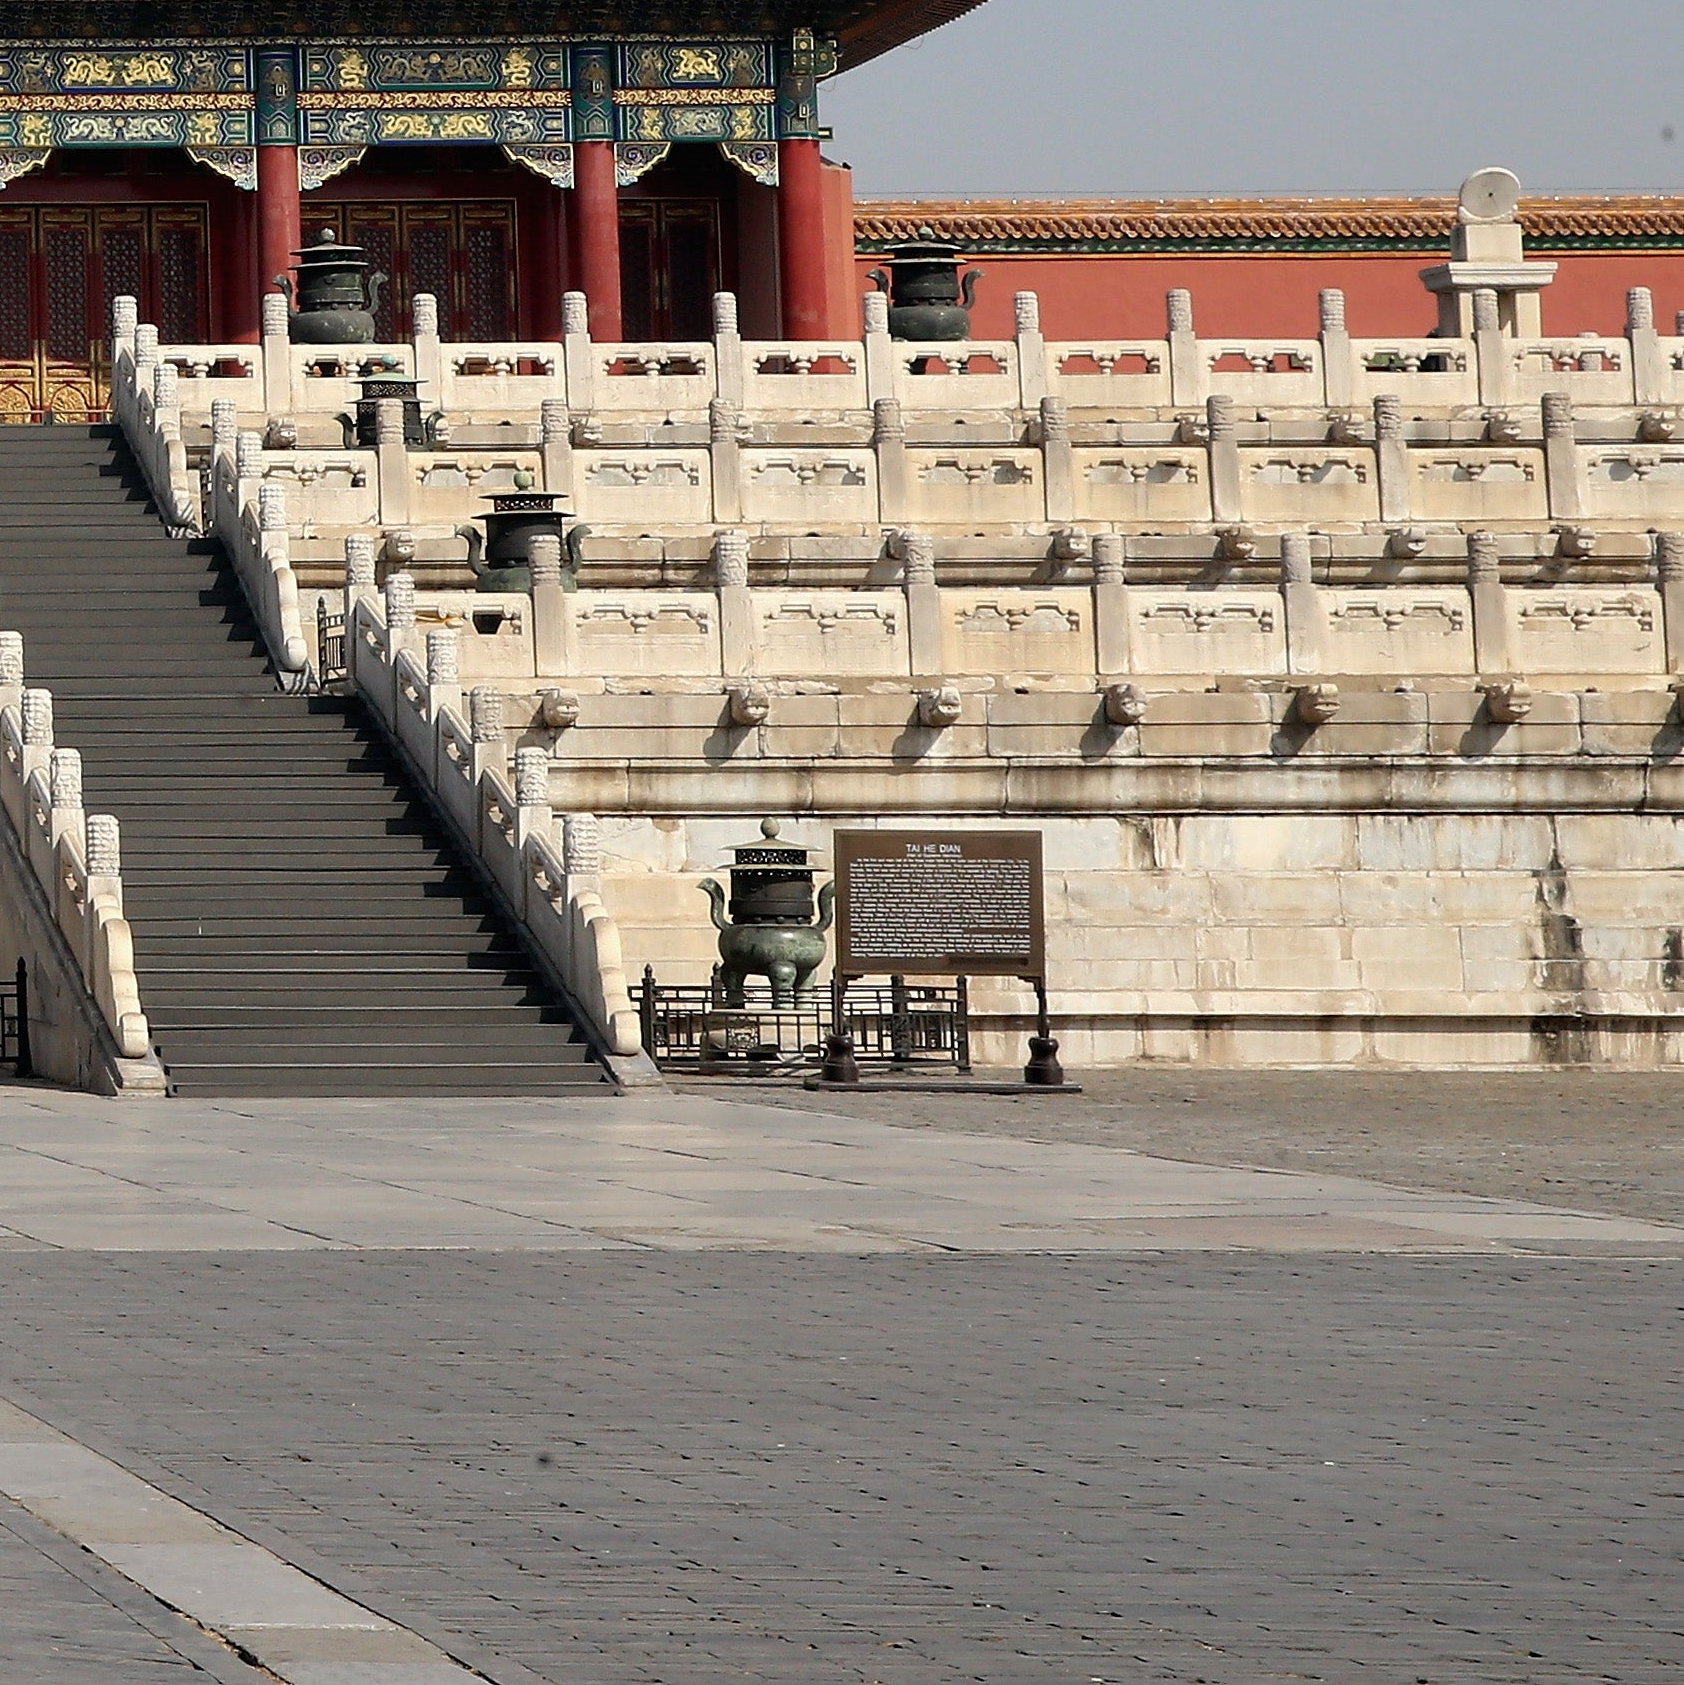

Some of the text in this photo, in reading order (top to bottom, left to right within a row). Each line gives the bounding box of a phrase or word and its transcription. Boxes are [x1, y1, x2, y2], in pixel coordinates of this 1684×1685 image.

[905, 843, 961, 853] TAI HE DIAN
